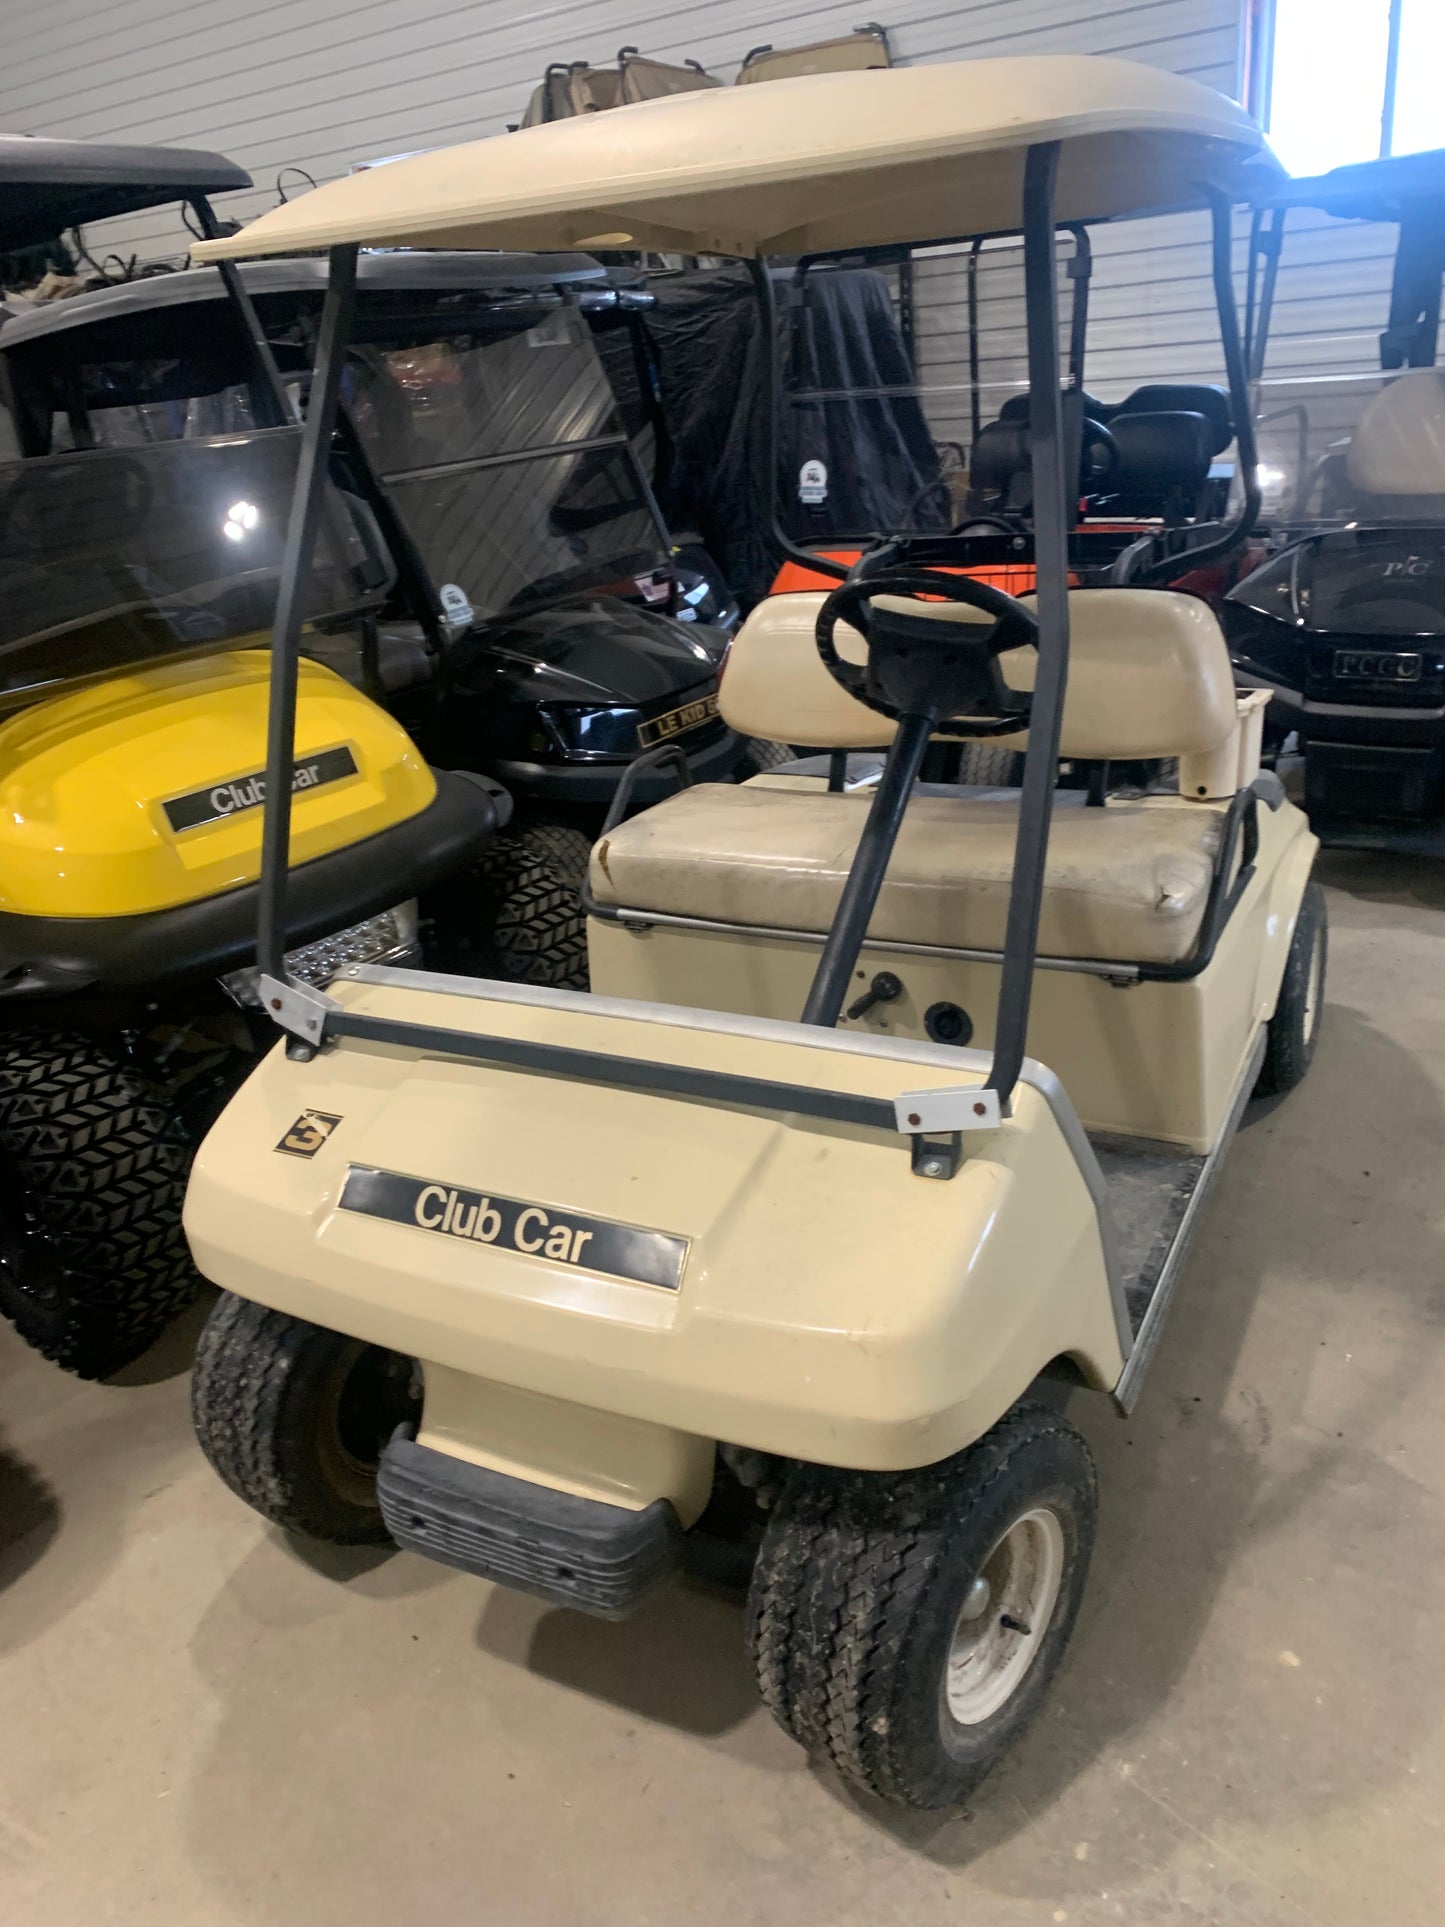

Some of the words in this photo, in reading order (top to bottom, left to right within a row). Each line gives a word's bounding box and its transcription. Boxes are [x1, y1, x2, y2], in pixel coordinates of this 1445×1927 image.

[657, 715, 679, 735] LE
[680, 703, 706, 725] KID
[210, 778, 266, 813] Club
[291, 764, 320, 790] ar
[414, 1184, 502, 1243] Club
[513, 1207, 594, 1264] Car
